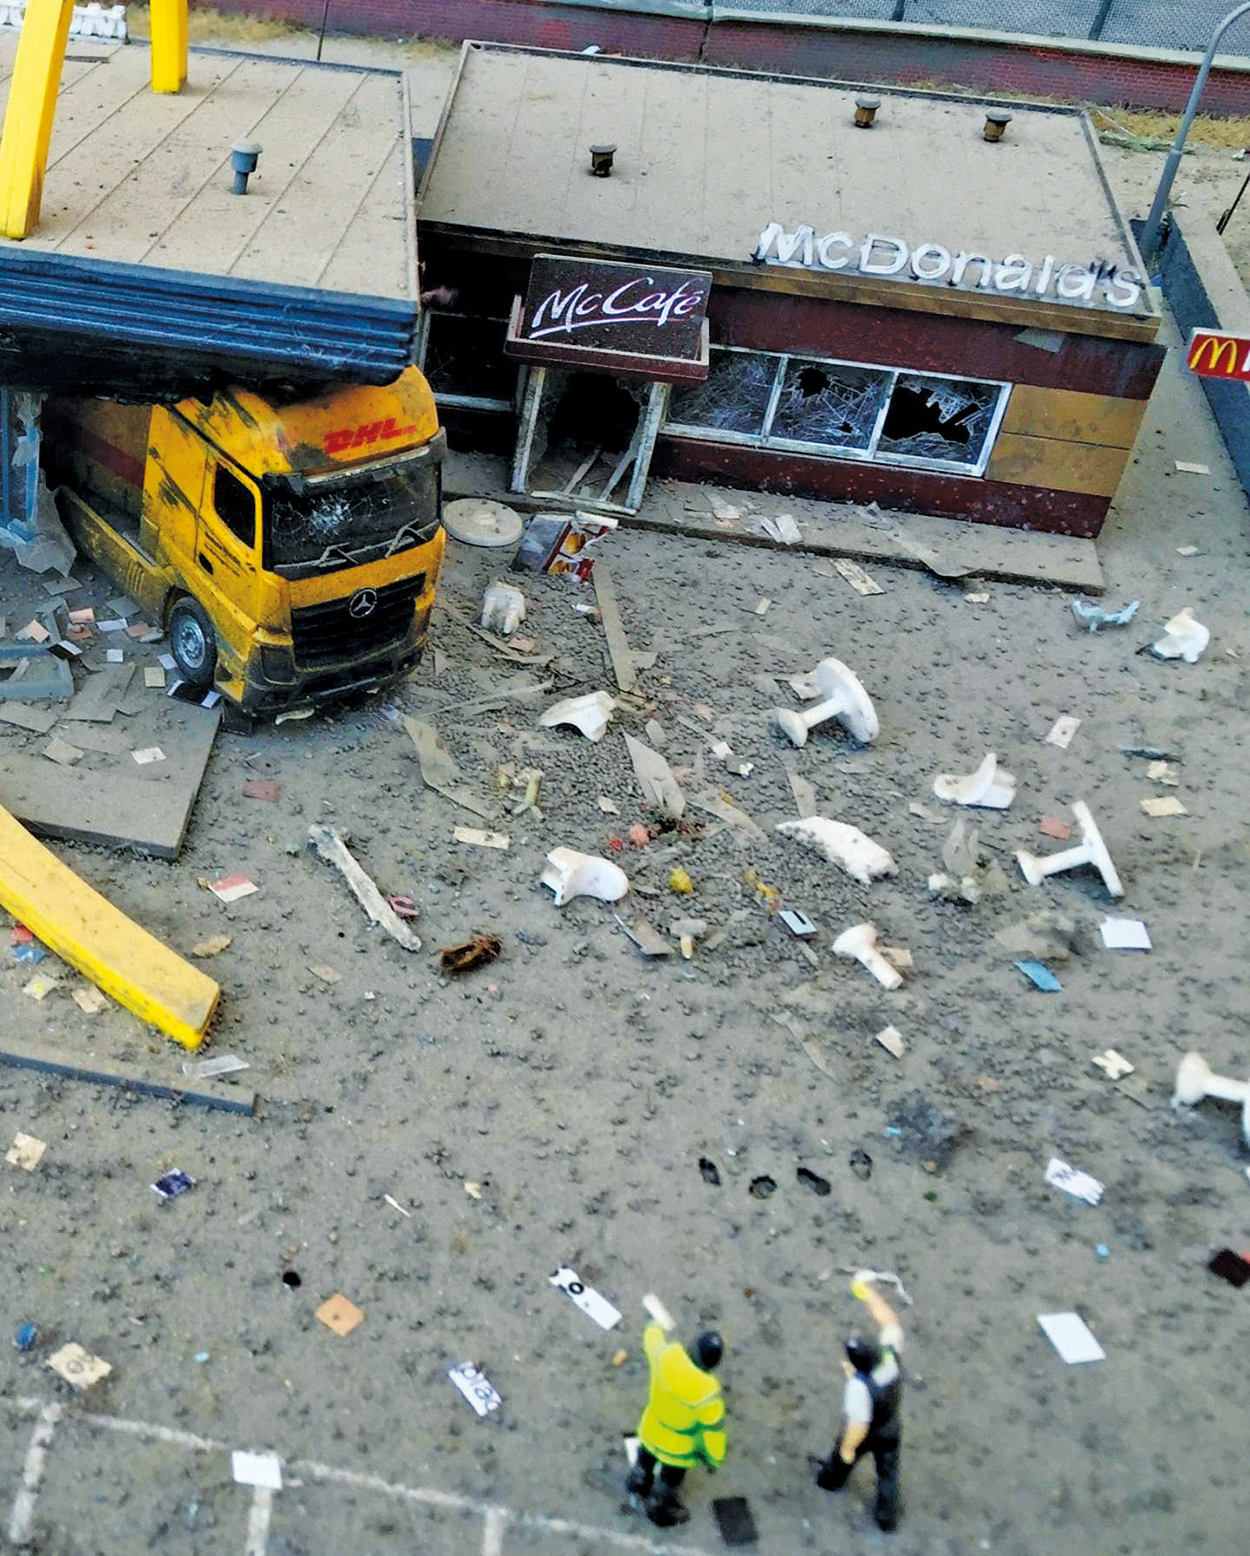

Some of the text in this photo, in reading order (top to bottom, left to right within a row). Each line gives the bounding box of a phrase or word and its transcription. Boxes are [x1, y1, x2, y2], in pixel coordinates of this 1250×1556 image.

[755, 222, 1142, 308] McDonald's
[530, 277, 705, 333] McCafé
[324, 418, 404, 454] DHL
